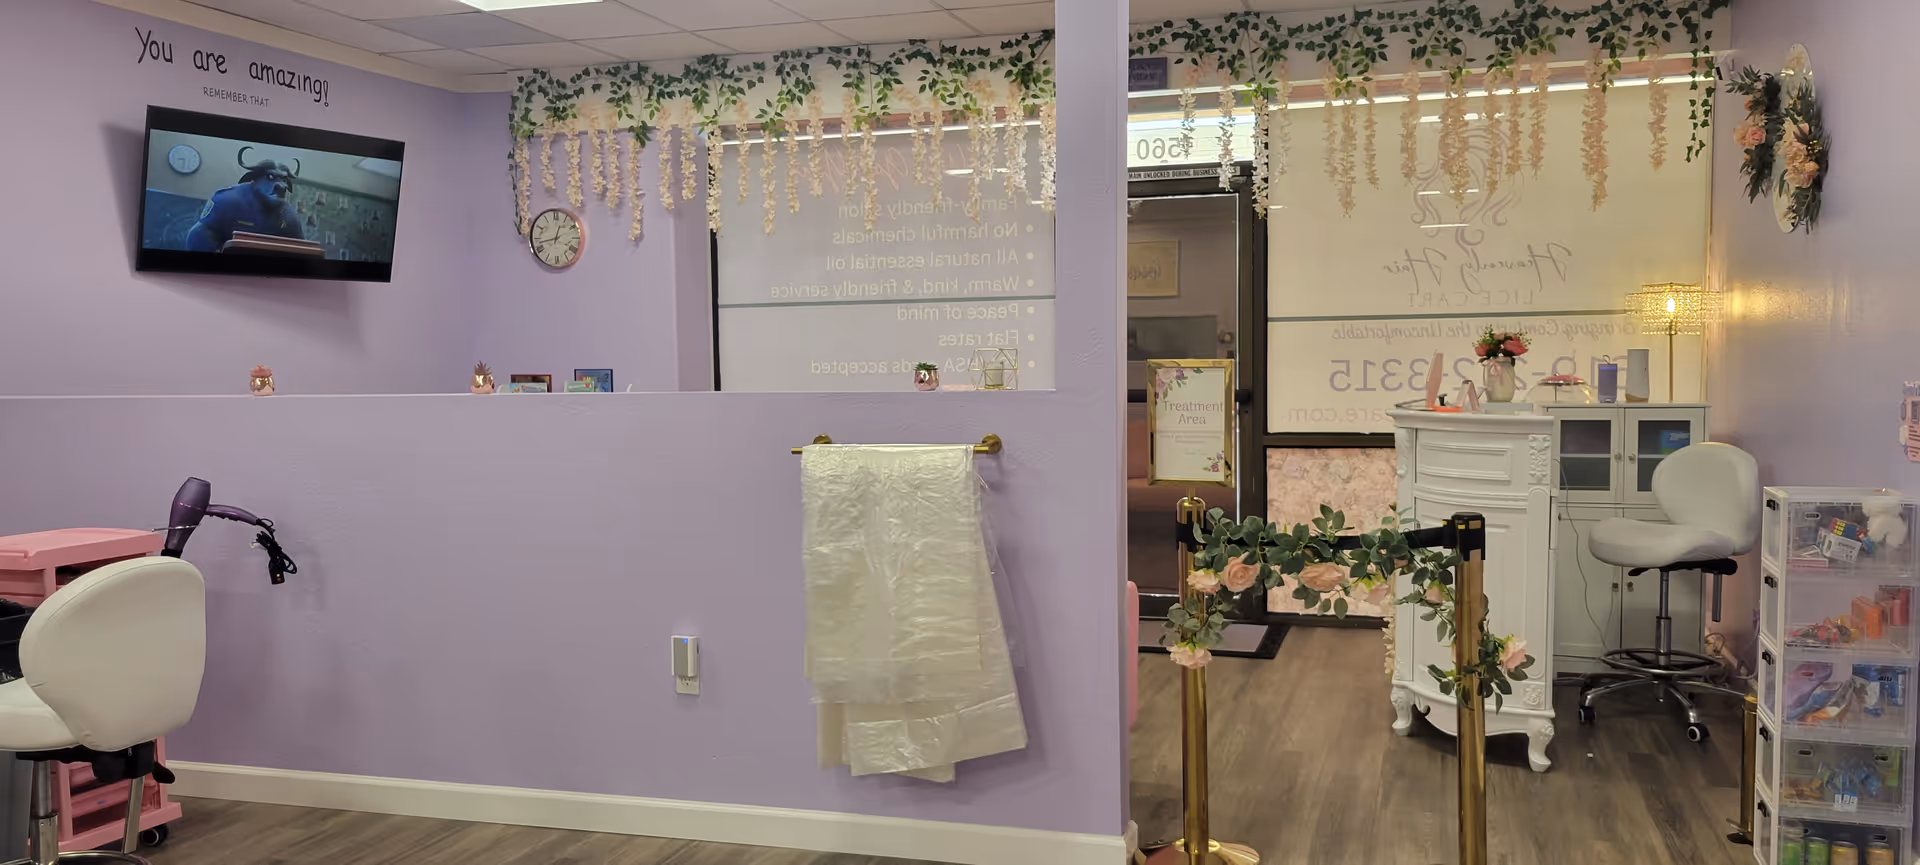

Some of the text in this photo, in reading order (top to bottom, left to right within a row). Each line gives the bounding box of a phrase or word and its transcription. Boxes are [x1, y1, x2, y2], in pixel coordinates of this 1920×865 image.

[135, 27, 329, 107] You are amazing!
[203, 86, 270, 108] REMEMBER THAT
[1143, 170, 1170, 179] UNLOCKED
[1172, 169, 1192, 178] DURING
[1193, 168, 1218, 177] BUSINESS
[1163, 400, 1223, 412] Treatment
[1178, 413, 1207, 425] Area
